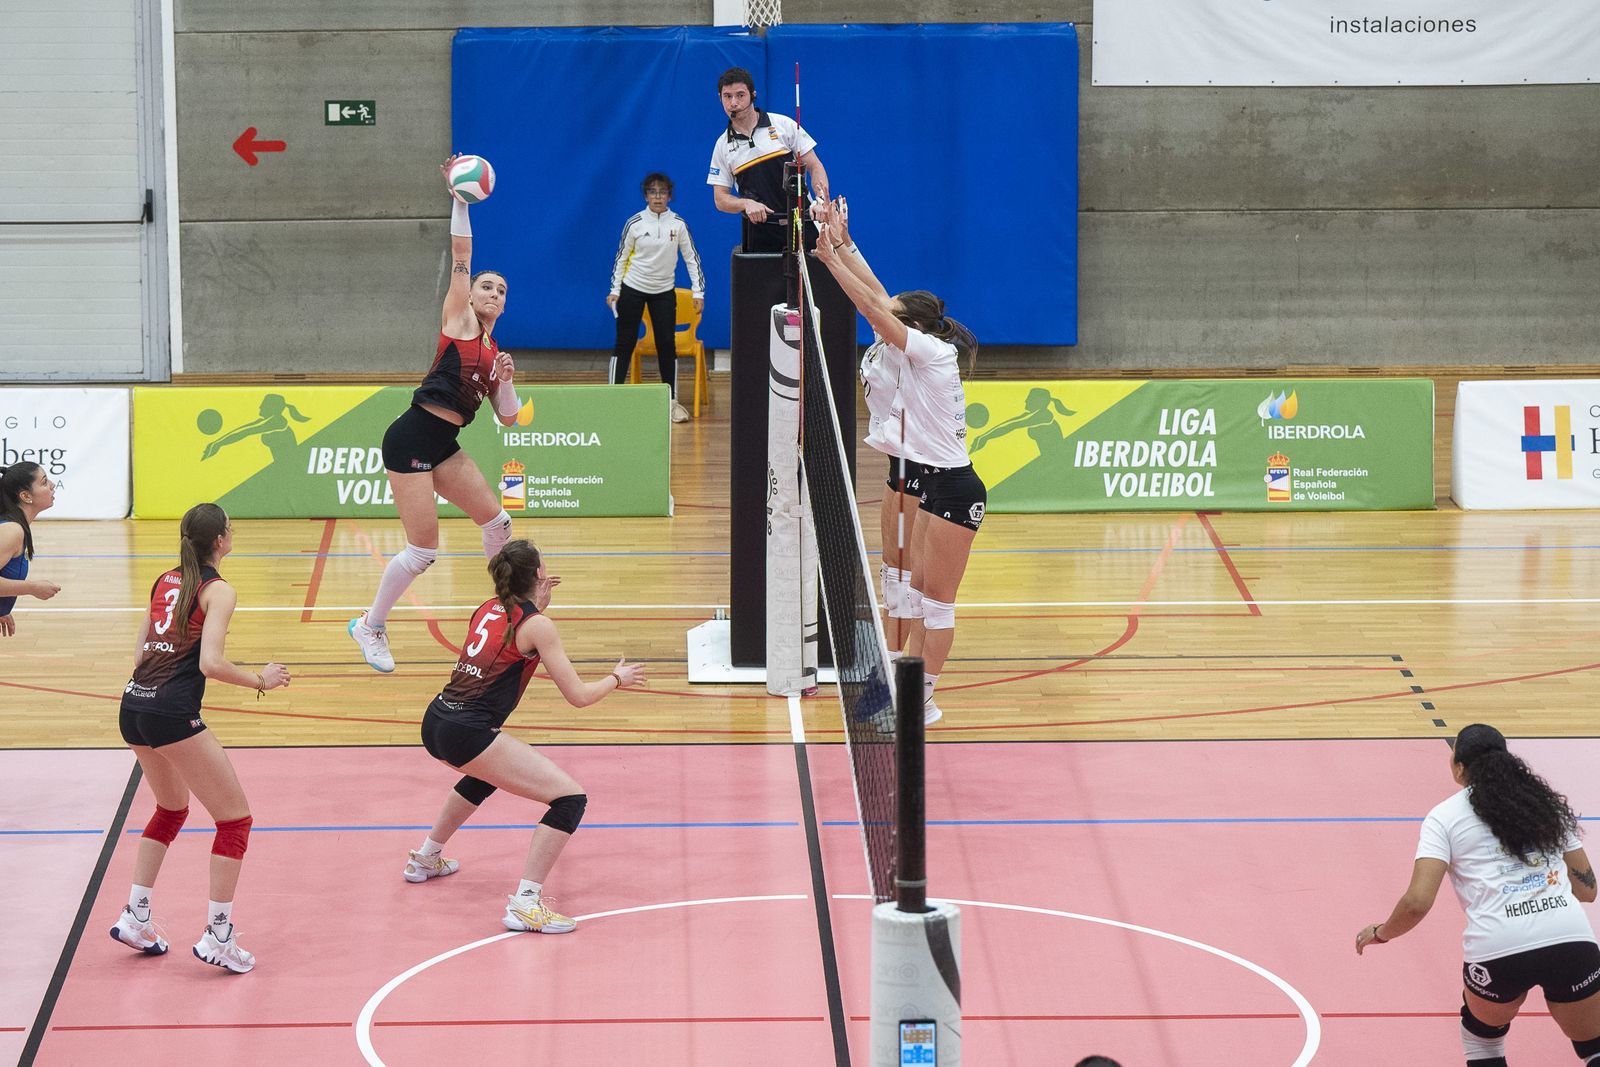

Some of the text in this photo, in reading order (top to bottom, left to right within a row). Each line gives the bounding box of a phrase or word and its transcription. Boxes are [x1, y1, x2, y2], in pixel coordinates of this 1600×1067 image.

[1330, 16, 1477, 33] instalaciones
[1158, 408, 1217, 436] LIGA
[503, 432, 601, 447] IBERDROLA
[1268, 425, 1366, 440] IBERDROLA
[307, 447, 388, 475] IBERD
[1074, 440, 1217, 468] IBERDROLA
[1293, 467, 1368, 477] Real Federación
[528, 475, 604, 485] Real Federación
[906, 478, 920, 491] 14
[1103, 472, 1215, 498] VOLEIBOL
[1293, 480, 1337, 490] Española
[528, 487, 572, 498] Española
[1294, 491, 1345, 501] de Voleibol
[528, 499, 580, 509] de Voleibol
[154, 588, 181, 635] 3
[466, 612, 502, 658] 5
[1504, 895, 1568, 918] HEIDELBERG
